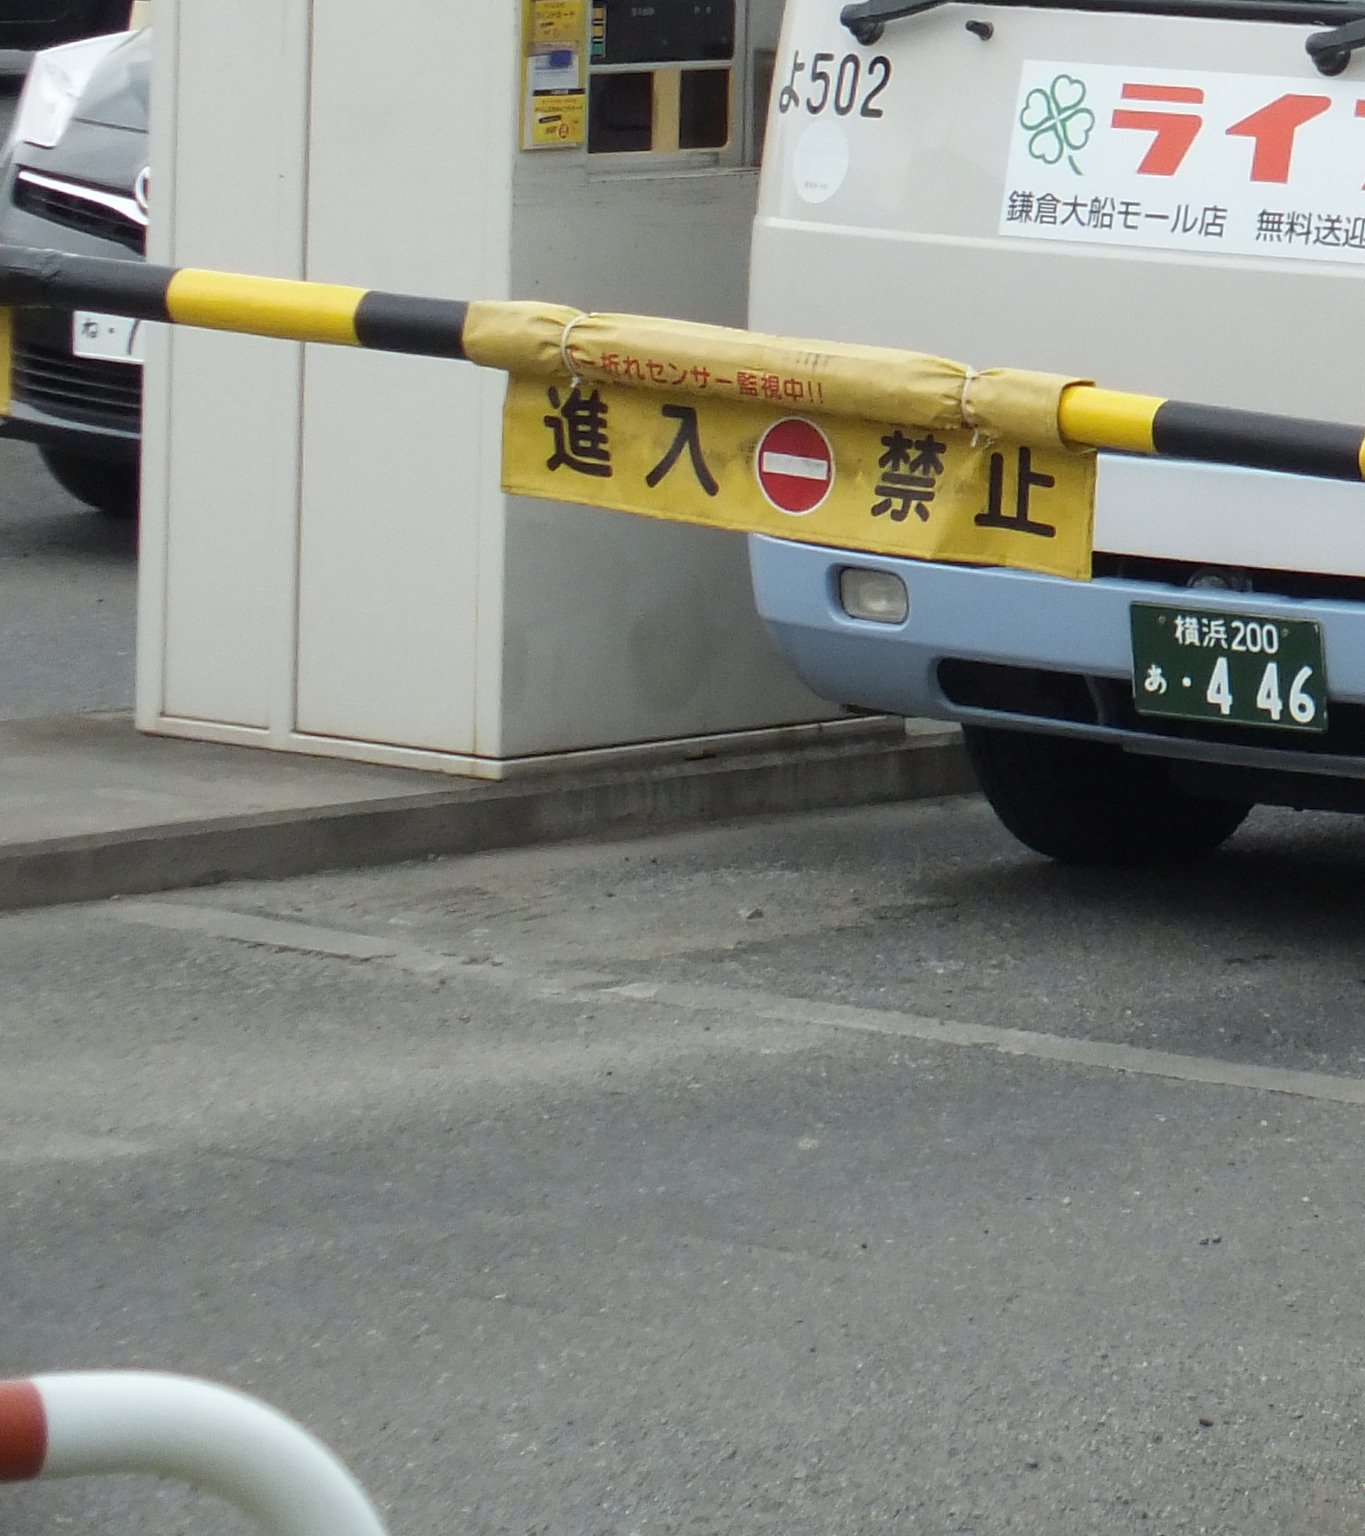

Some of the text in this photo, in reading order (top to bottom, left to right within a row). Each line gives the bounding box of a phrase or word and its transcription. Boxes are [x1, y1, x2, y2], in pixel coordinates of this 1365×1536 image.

[778, 47, 893, 120] よ502
[1005, 188, 1229, 240] 鎌倉大船モール店
